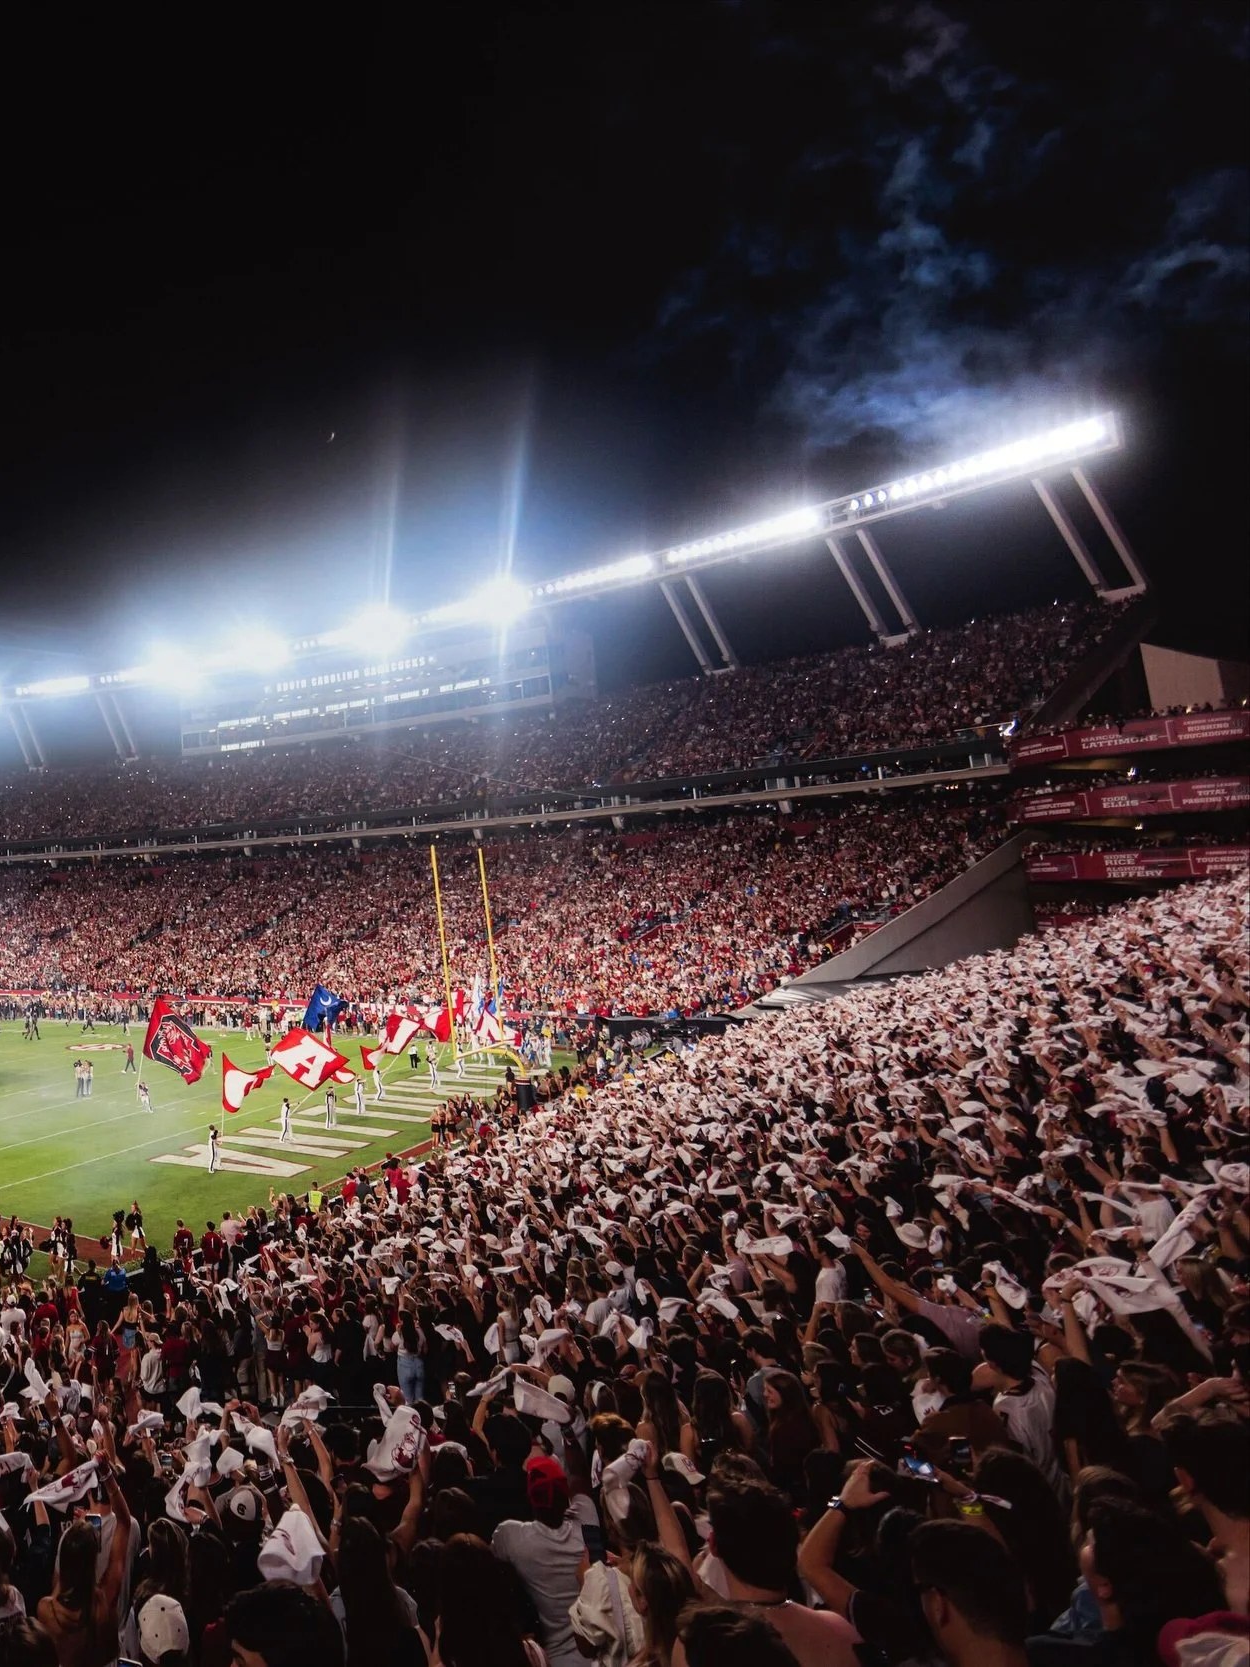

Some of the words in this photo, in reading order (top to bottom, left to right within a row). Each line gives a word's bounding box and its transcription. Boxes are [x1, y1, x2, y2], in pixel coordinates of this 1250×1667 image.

[276, 679, 306, 692] SOUTH
[311, 669, 359, 686] CAROLINA
[363, 656, 426, 676] GAMECOCKS
[1187, 723, 1229, 732] RUSHING
[1081, 734, 1122, 743] MARCUS
[1177, 729, 1244, 740] TOUCHDOWNS
[1082, 734, 1159, 749] LATTIMORE
[1197, 788, 1228, 796] TOTAL
[1102, 799, 1139, 808] ELLIS
[1182, 796, 1222, 804] PASSING
[1106, 870, 1163, 878] JEFFERY
[271, 1034, 338, 1089] A
[177, 1282, 183, 1295] 7
